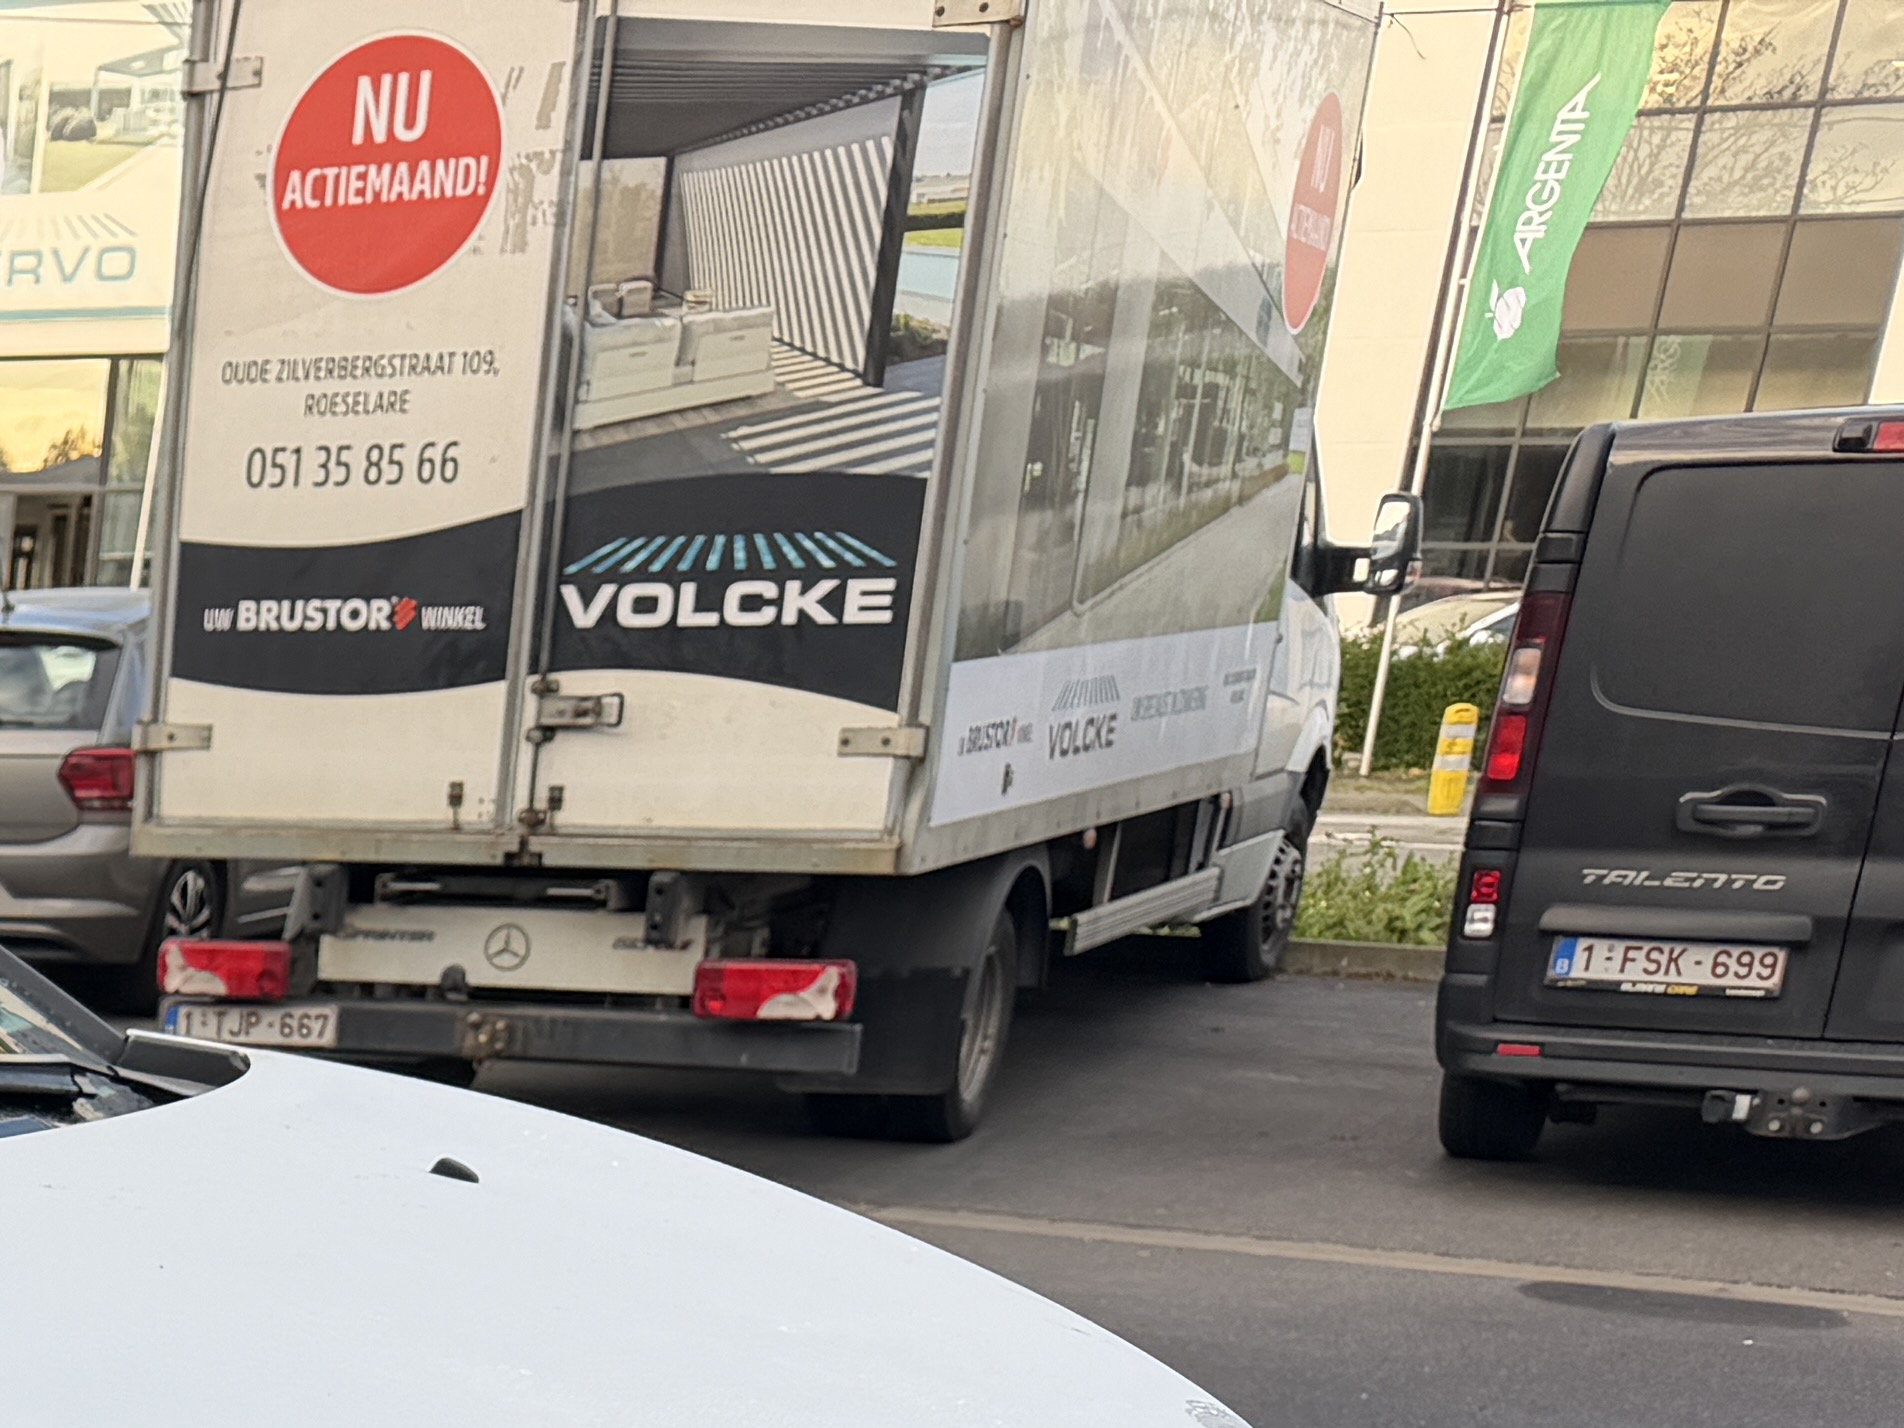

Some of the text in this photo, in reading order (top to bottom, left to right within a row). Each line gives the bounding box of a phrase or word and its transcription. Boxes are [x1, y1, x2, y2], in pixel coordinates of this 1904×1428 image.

[351, 69, 433, 146] NU
[281, 155, 489, 211] ACTIEMAAND!
[1513, 71, 1602, 275] ARGENTA
[221, 349, 500, 385] OUDE ZILVERBERGSTRAAT 109,
[303, 389, 411, 418] ROESELARE
[246, 440, 460, 489] 051 35 85 66
[203, 598, 487, 633] UW BRUSTOR WINKEL
[559, 577, 898, 630] VOLCKE
[1048, 712, 1118, 760] VOLCKE
[1581, 868, 1787, 891] TALENTO
[1580, 943, 1780, 982] 1-FSK-699
